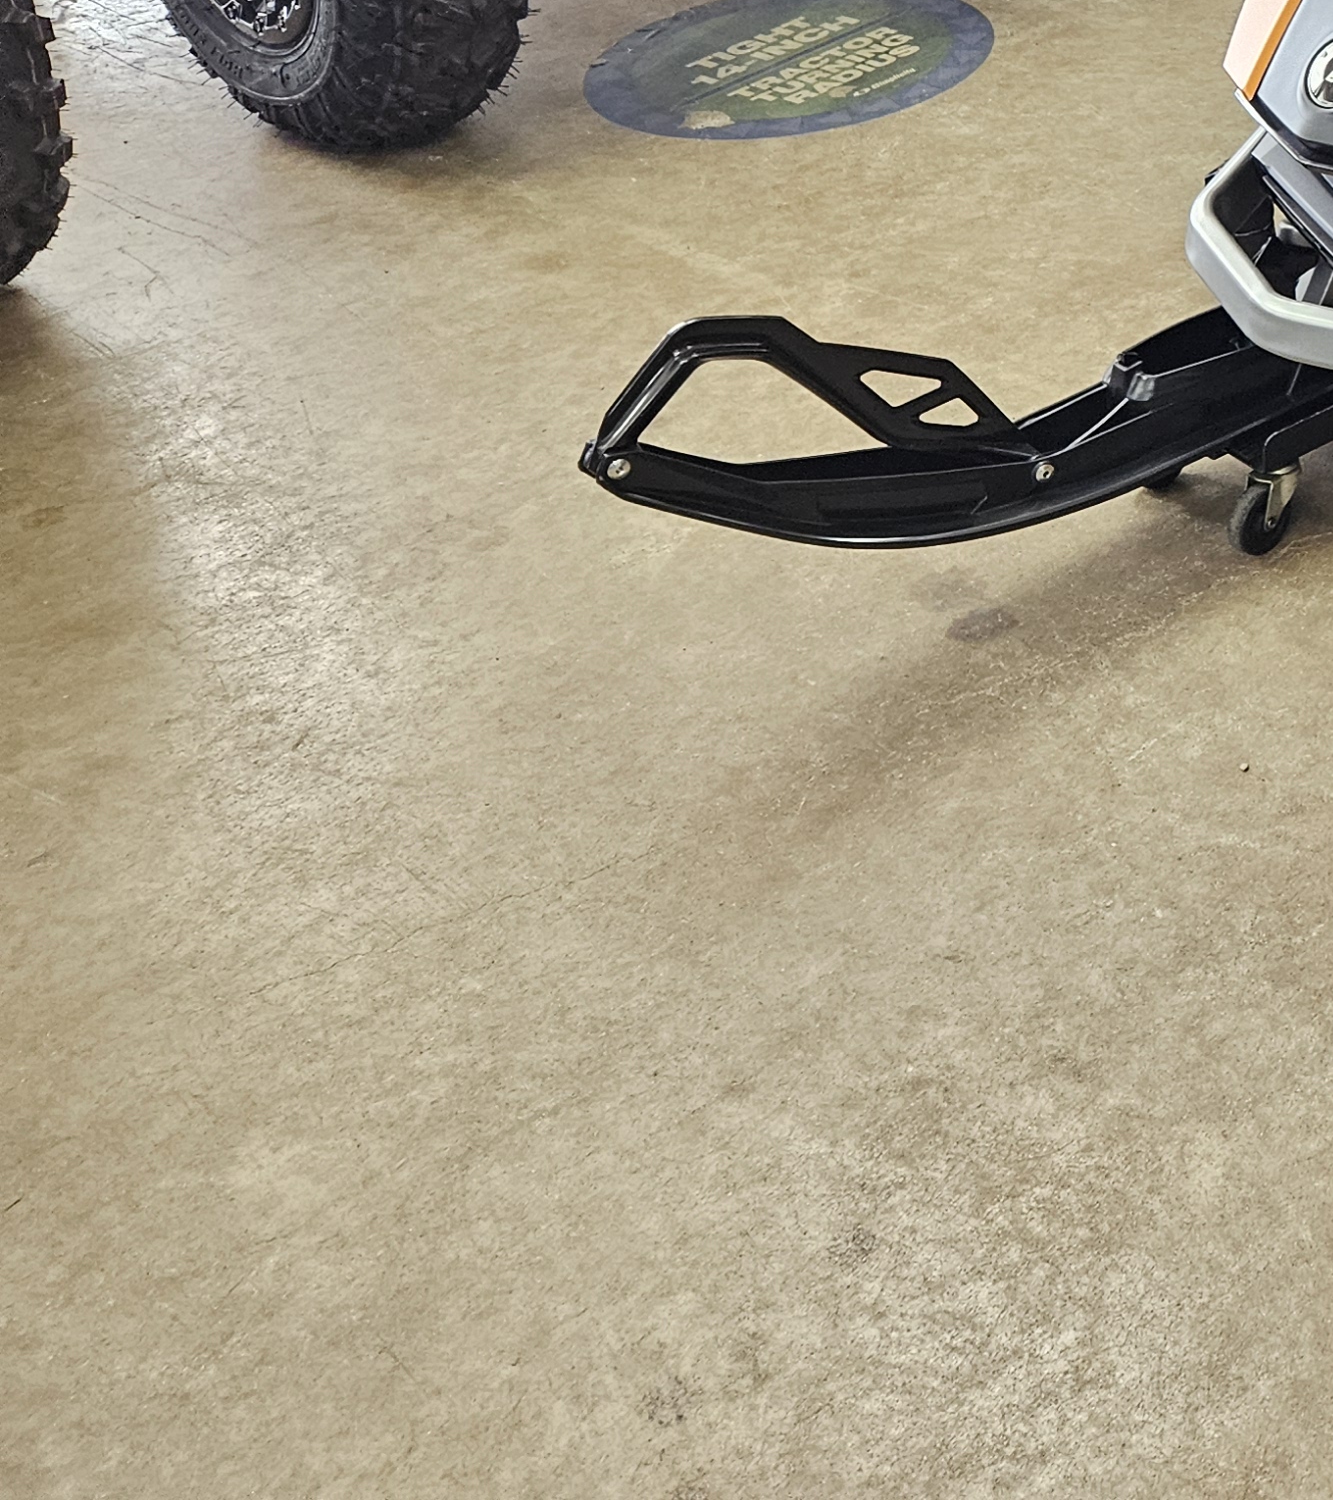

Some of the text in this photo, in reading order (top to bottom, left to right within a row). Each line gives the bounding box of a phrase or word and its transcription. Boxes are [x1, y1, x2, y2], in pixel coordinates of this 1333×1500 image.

[685, 15, 812, 69] TIGHT
[690, 15, 861, 86] 14-INCH
[727, 26, 899, 98] TRACTOR
[749, 33, 915, 102] TURNING
[783, 44, 921, 105] RADIUS
